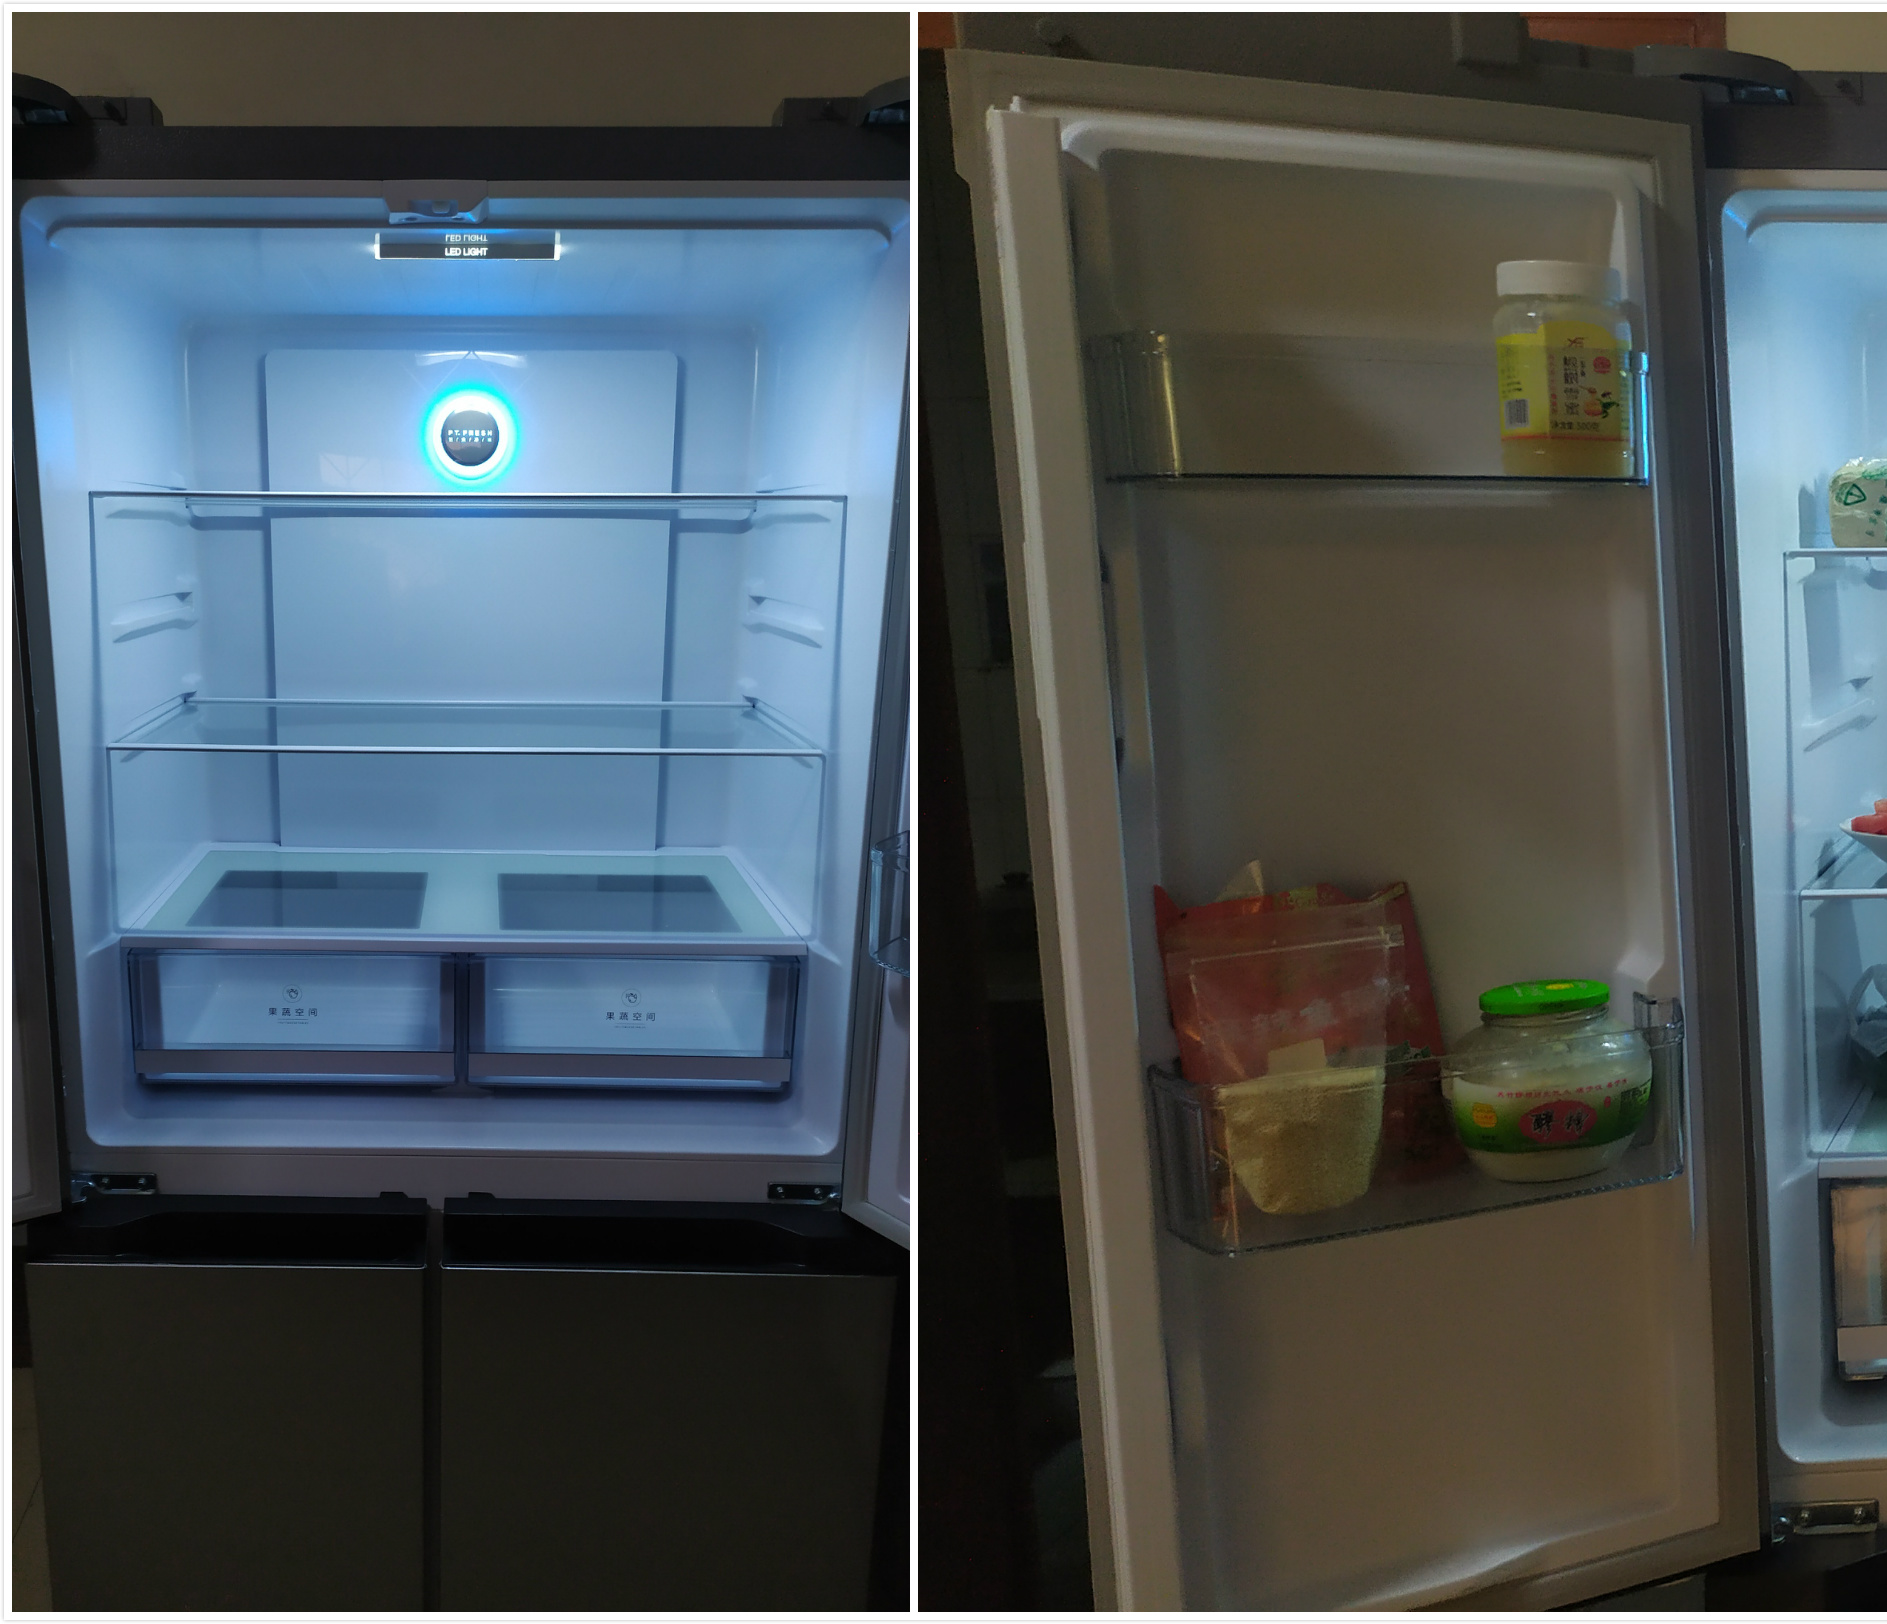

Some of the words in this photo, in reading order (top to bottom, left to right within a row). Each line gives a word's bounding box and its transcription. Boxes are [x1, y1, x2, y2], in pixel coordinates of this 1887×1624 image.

[444, 247, 462, 257] LED
[463, 247, 489, 257] LIGHT
[268, 1007, 318, 1017] 果蔬空间
[605, 1011, 656, 1022] 果蔬空间
